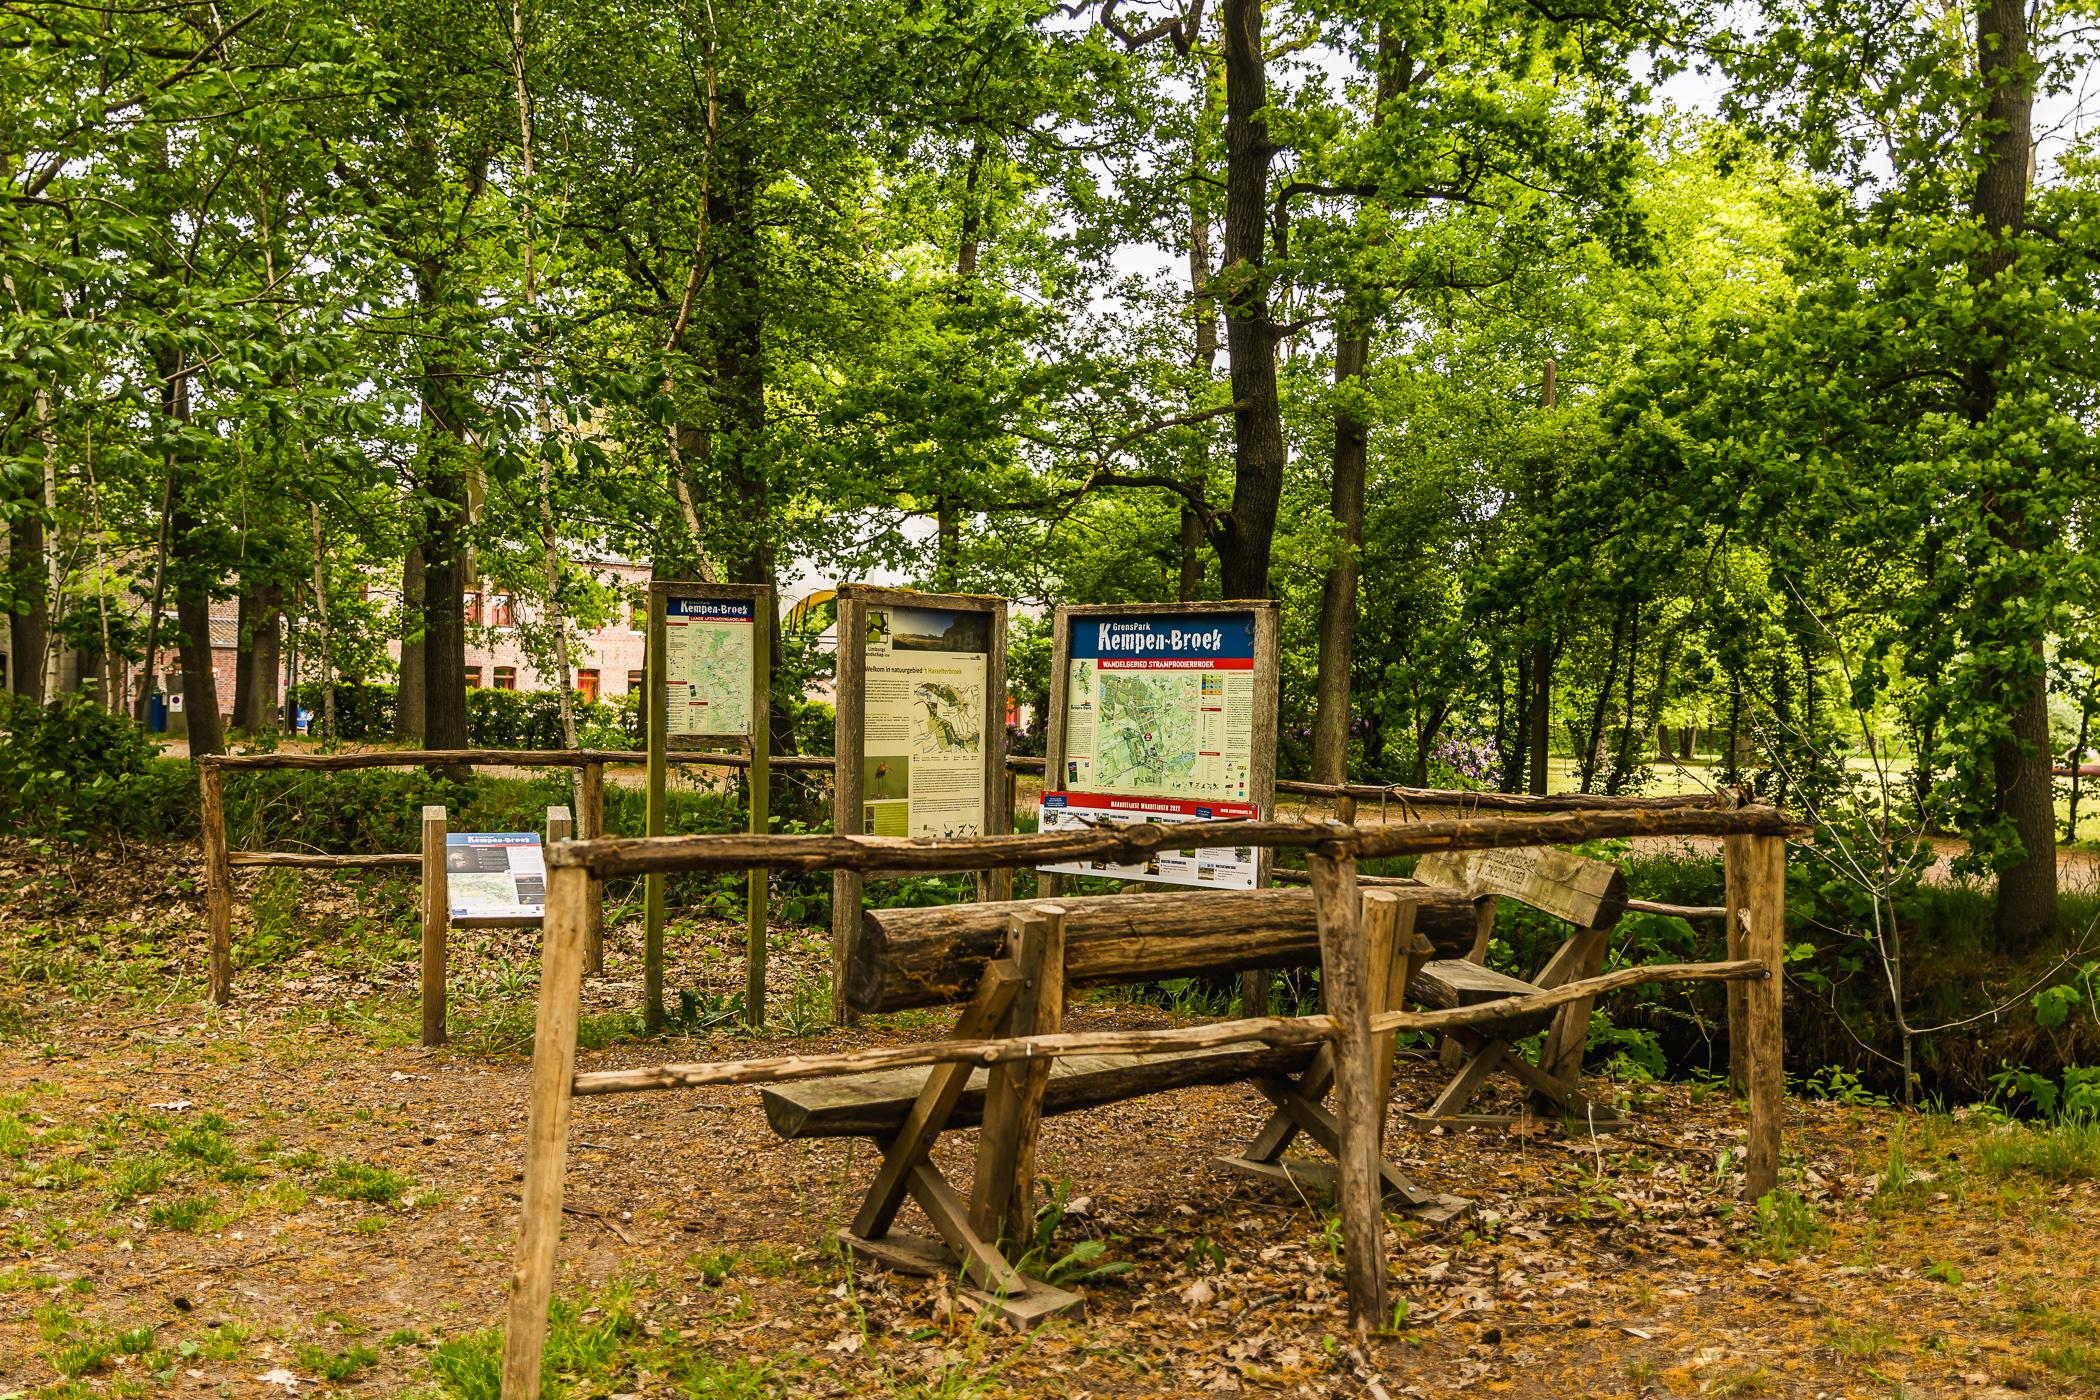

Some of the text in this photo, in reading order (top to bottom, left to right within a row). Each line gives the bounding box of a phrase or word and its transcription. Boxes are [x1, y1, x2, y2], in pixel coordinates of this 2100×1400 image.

[1112, 622, 1151, 631] GrensPark
[1102, 660, 1215, 668] WANDELGEBIED STRAMPROOIERBROEK
[891, 667, 923, 675] natuurgebied
